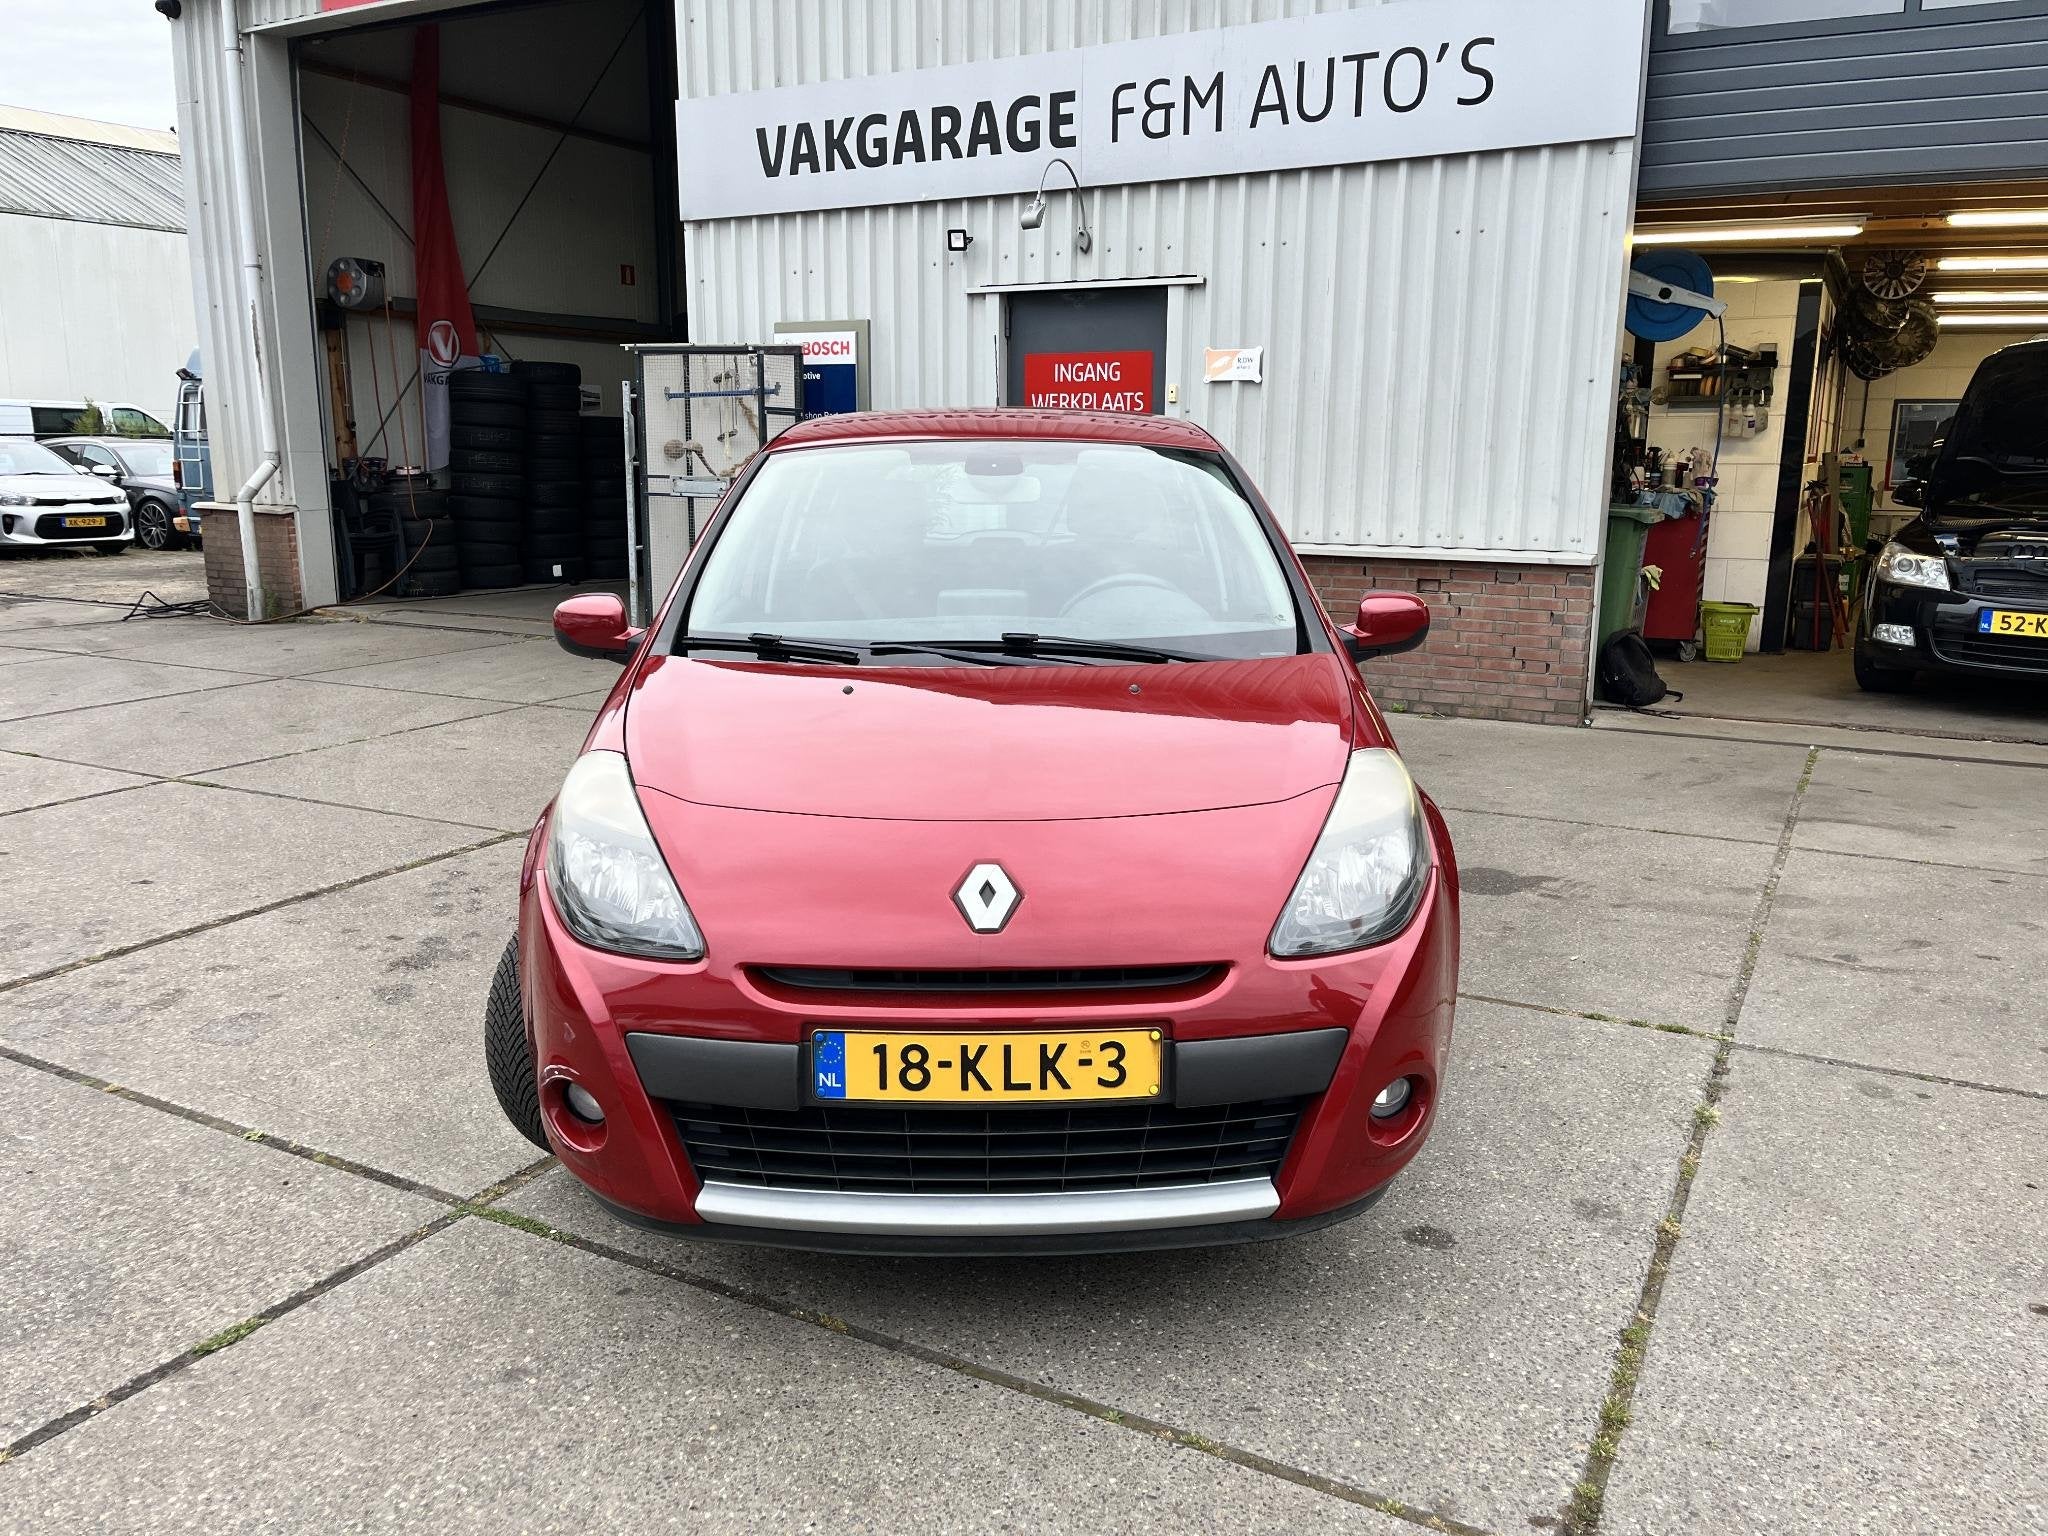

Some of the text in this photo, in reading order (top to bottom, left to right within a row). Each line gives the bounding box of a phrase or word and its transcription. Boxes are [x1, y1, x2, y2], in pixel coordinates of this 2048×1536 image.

[756, 37, 1495, 178] VAKGARAGE F&M AUTO'S
[801, 341, 850, 355] BOSCH
[1054, 362, 1121, 382] INGANG
[1031, 391, 1145, 412] WERKPLAATS
[2000, 615, 2048, 634] 52-K
[872, 1041, 1128, 1091] 18-KLK-3
[818, 1073, 842, 1088] NL
